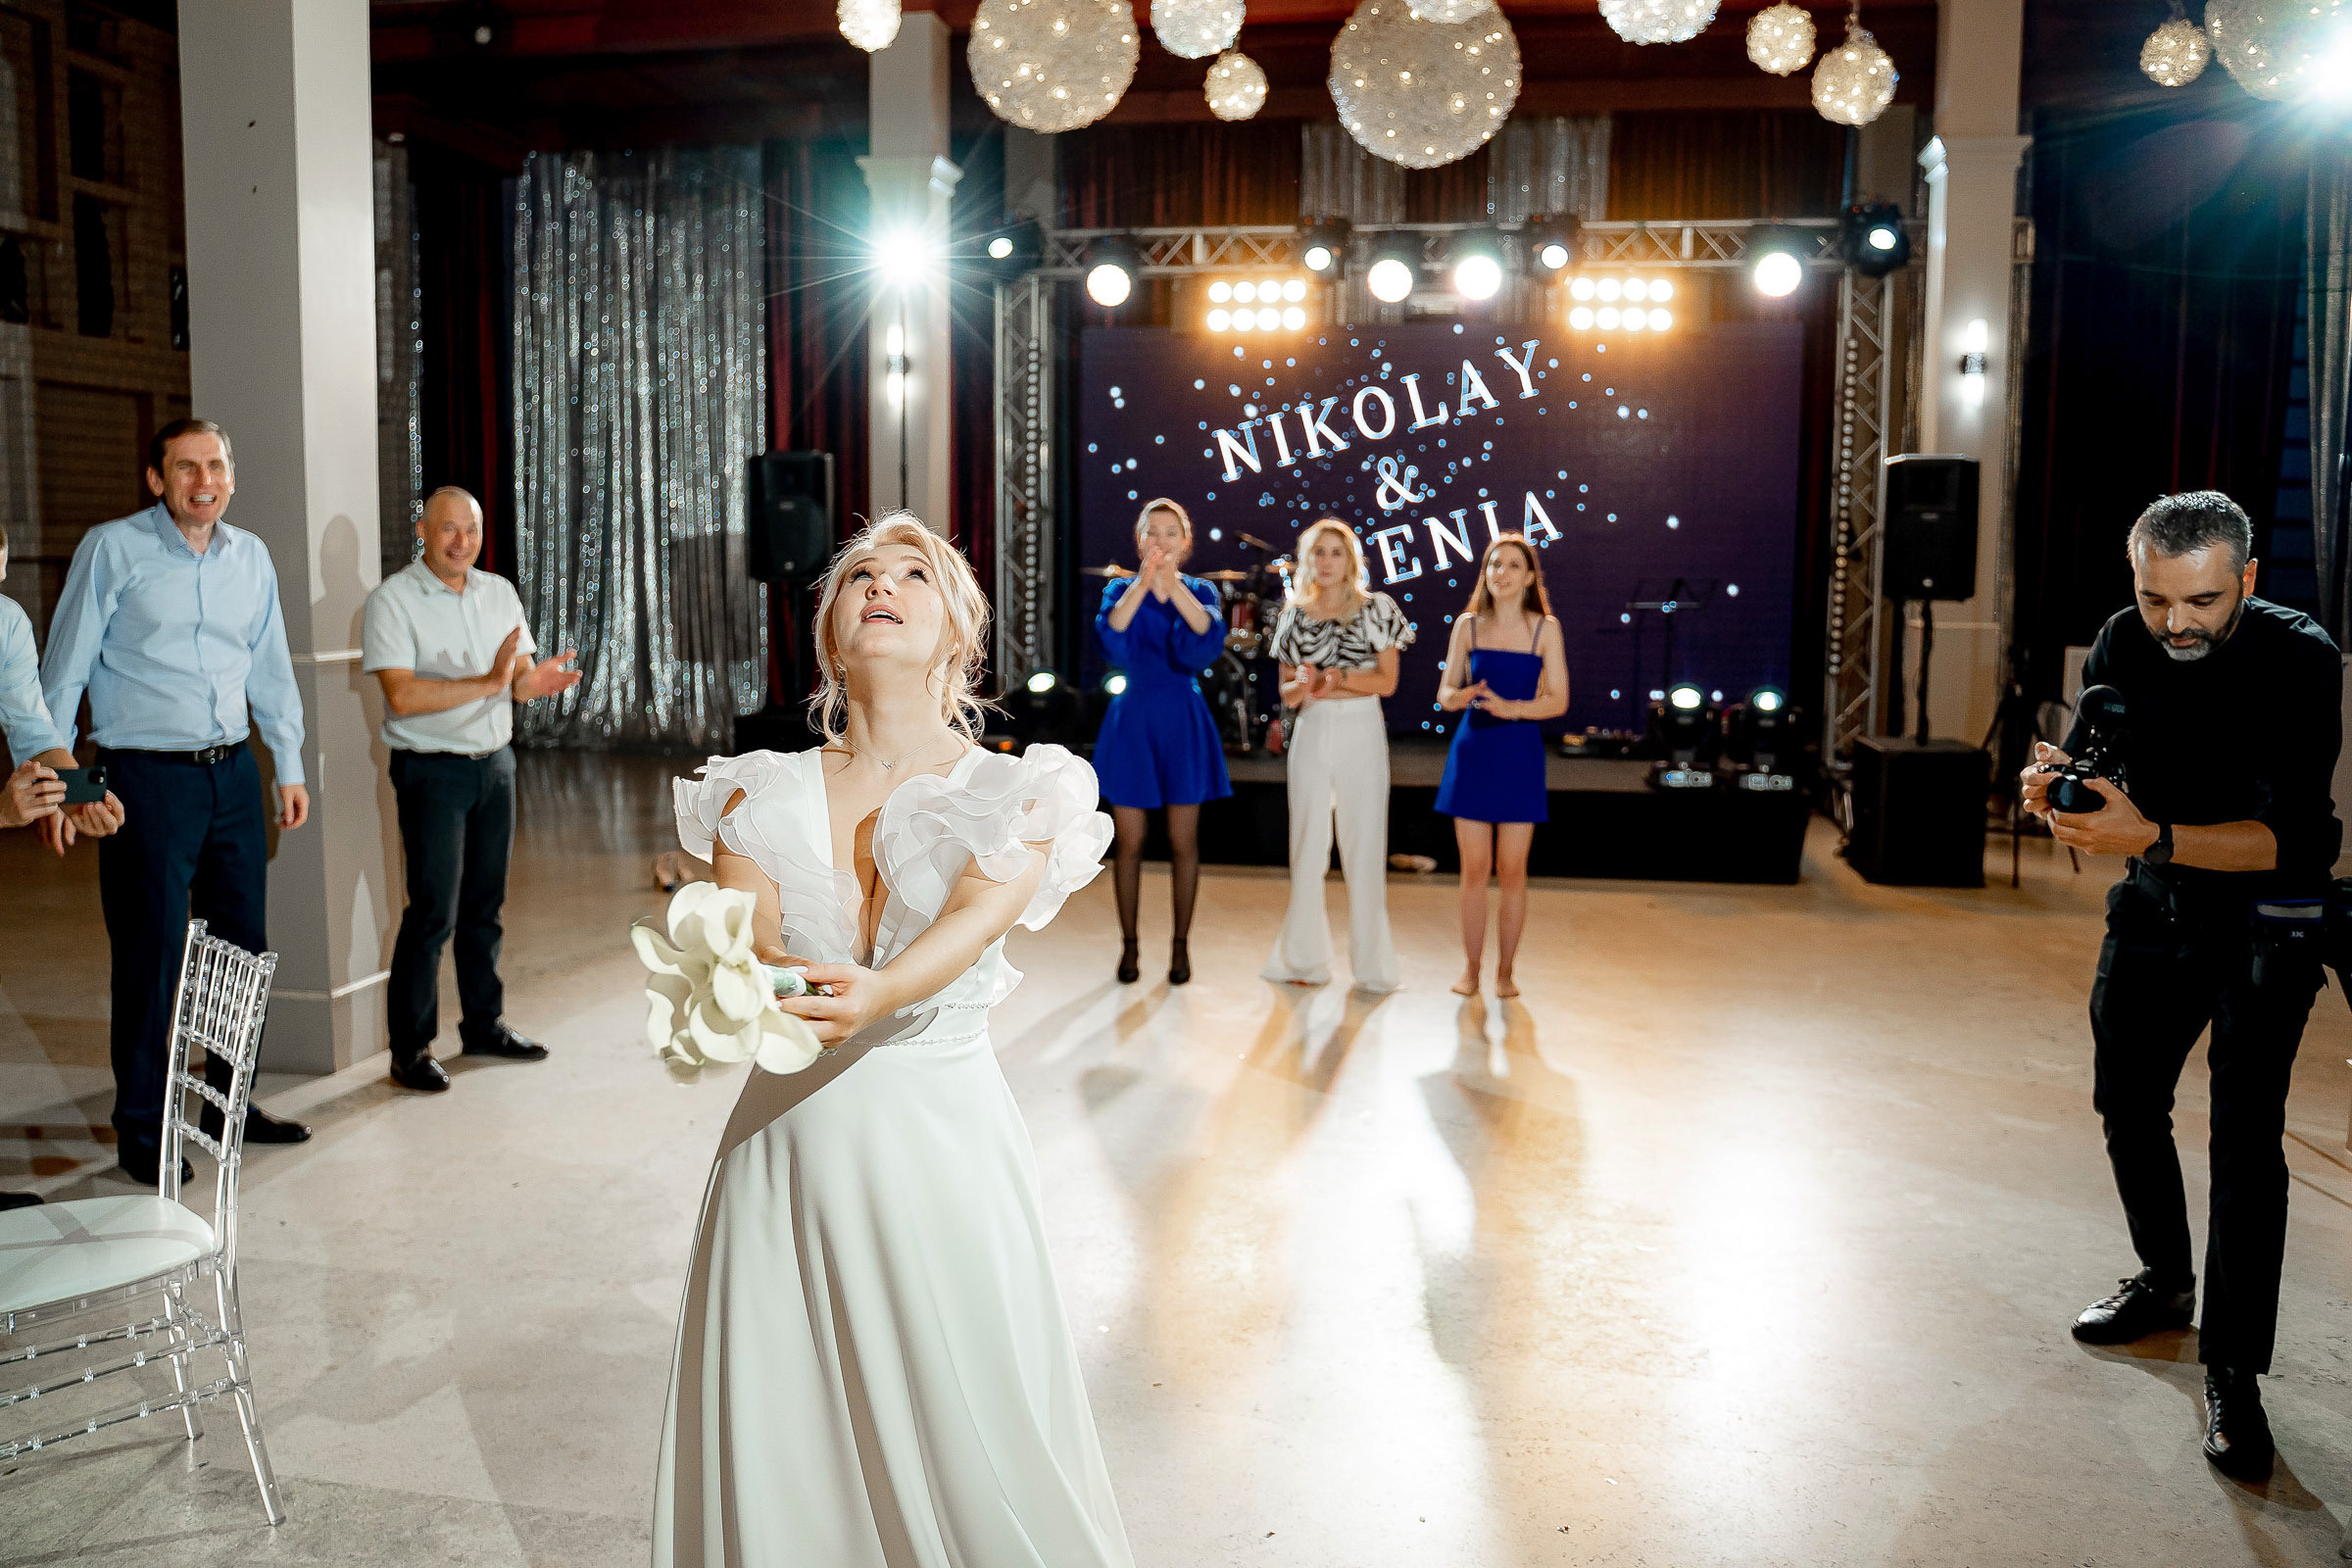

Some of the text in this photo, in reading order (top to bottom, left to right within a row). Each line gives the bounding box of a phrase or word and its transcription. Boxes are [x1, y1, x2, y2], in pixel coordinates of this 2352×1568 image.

[1211, 339, 1540, 482] NIKOLAY
[1376, 456, 1425, 510] &
[1272, 491, 1562, 600] ENIA
